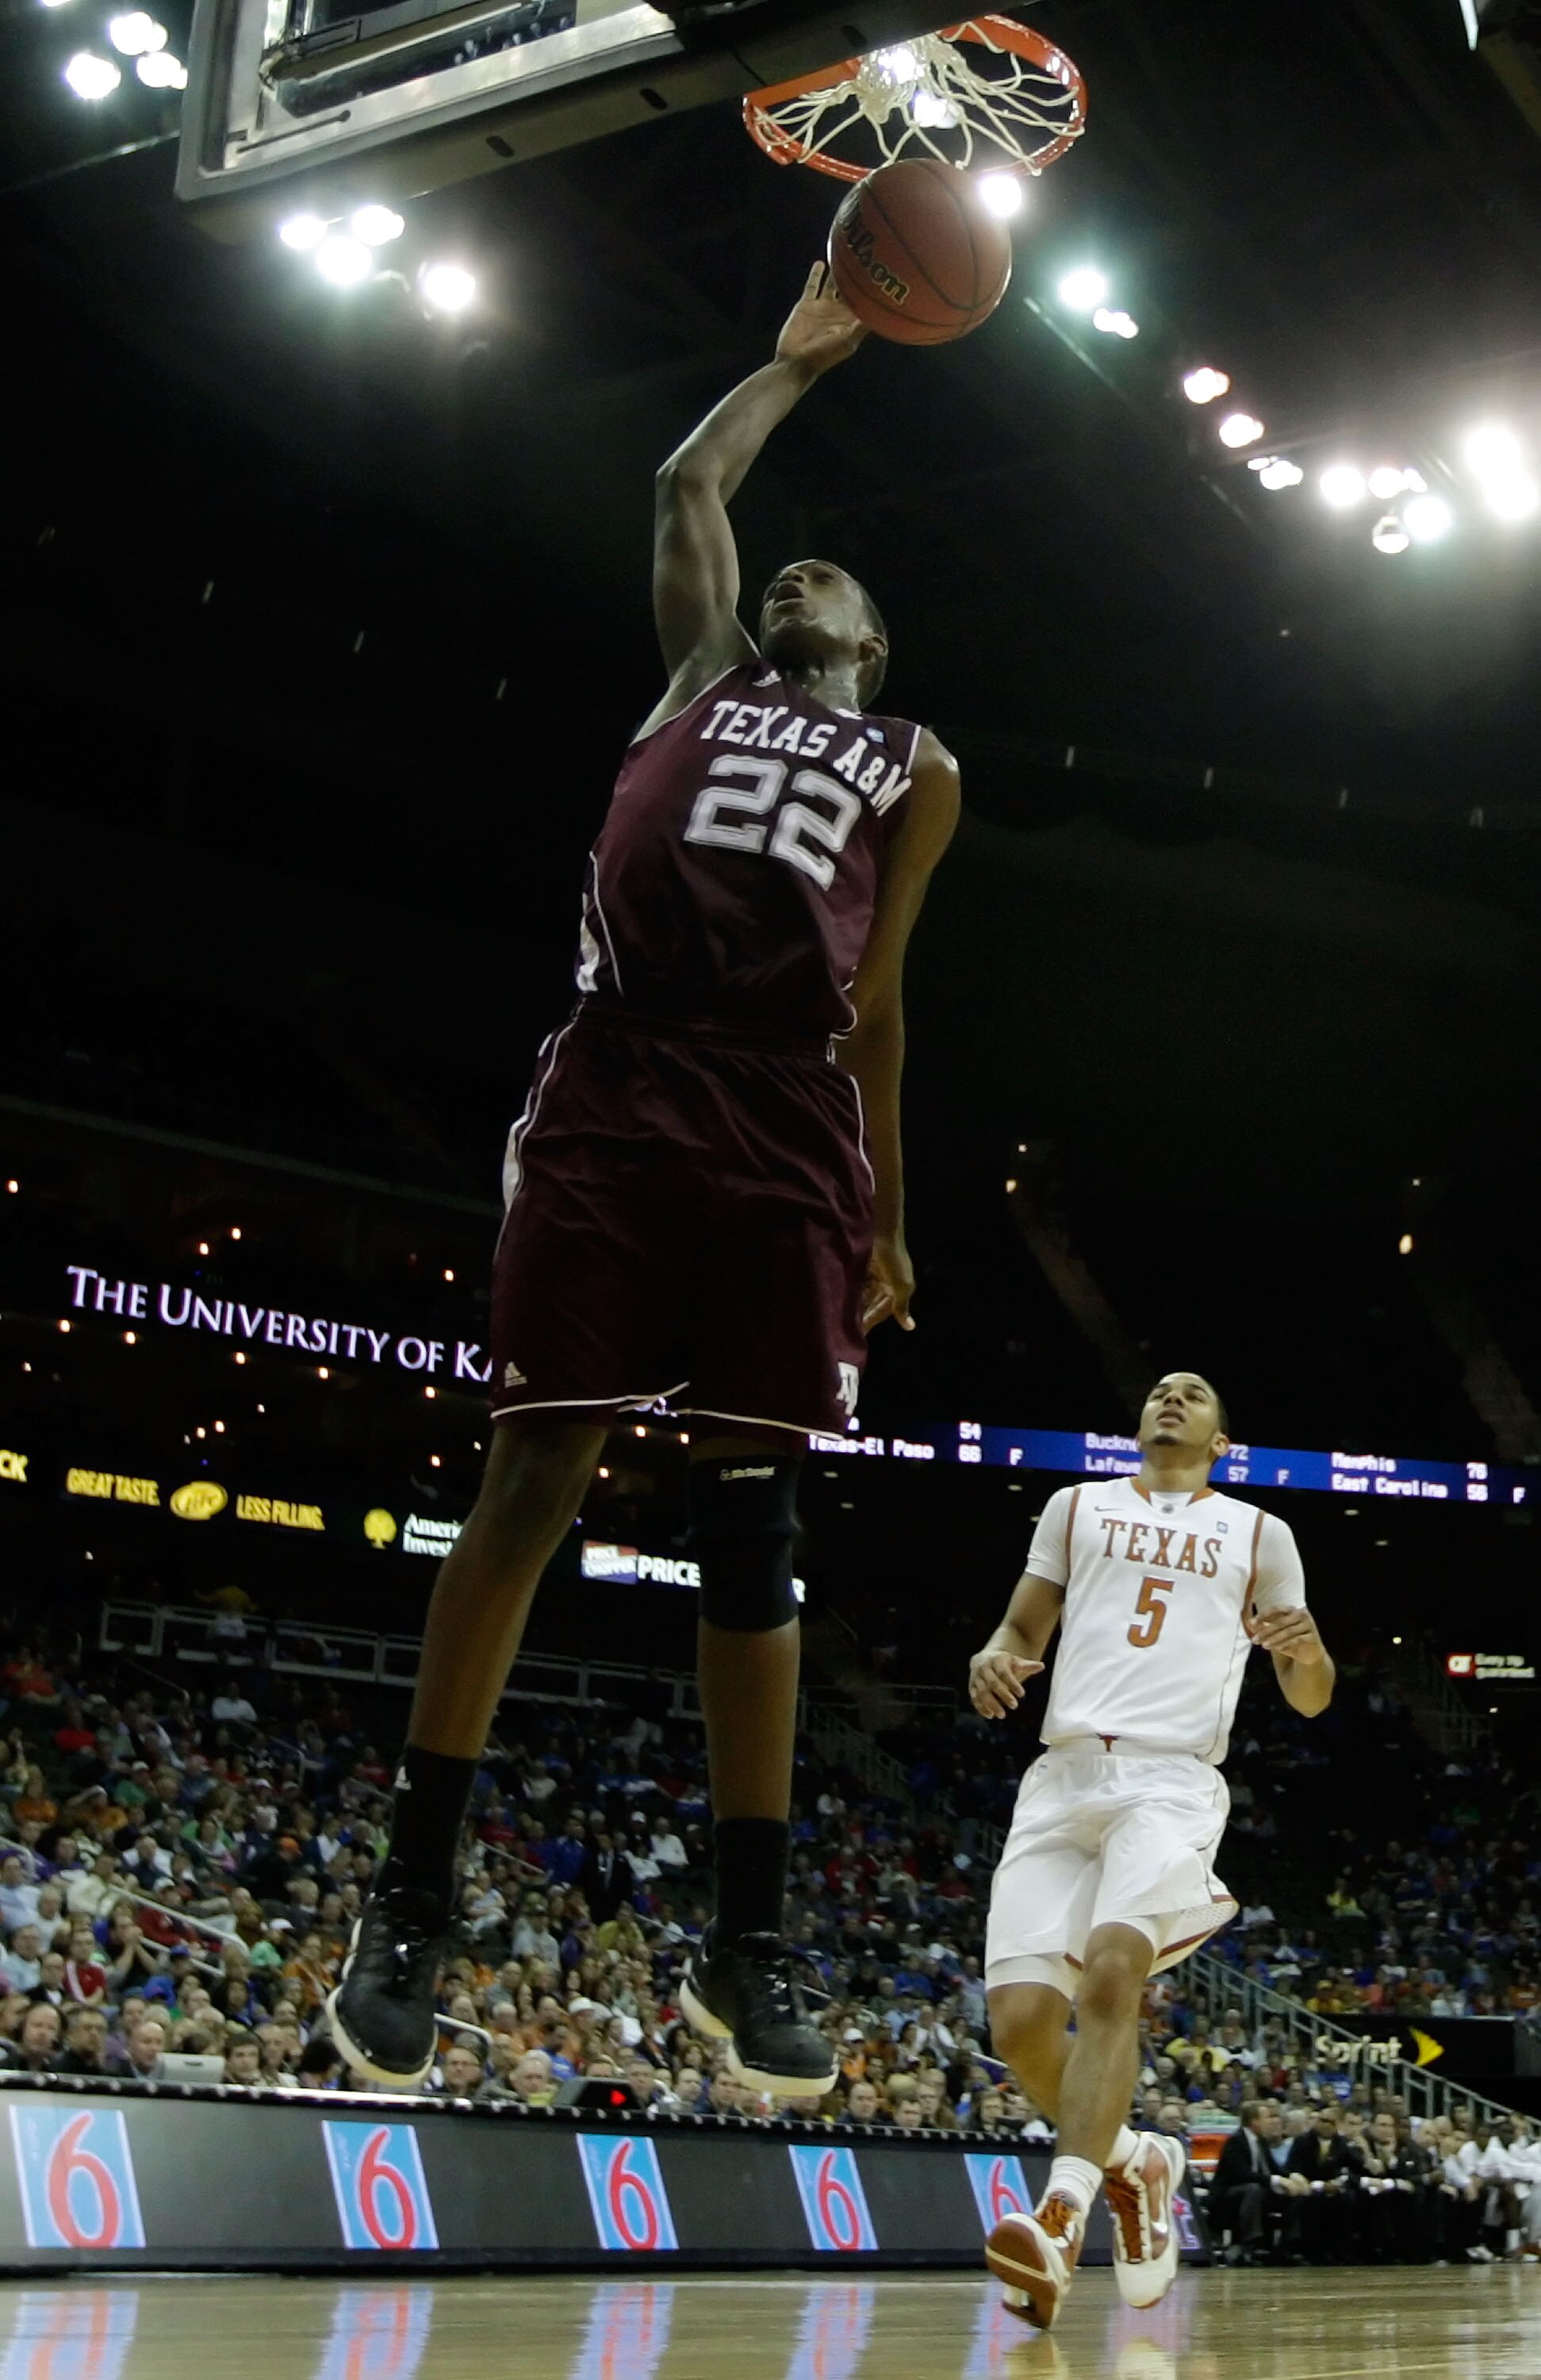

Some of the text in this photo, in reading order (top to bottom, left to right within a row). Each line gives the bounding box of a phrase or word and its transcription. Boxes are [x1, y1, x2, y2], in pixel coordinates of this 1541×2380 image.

[700, 701, 911, 817] TEXAS A&M
[683, 754, 861, 892] 22
[66, 1265, 148, 1319] THE
[159, 1283, 390, 1363] UNIVERSITY
[397, 1336, 445, 1373] OF
[892, 1439, 934, 1459] Paso
[1008, 1448, 1023, 1465] F
[1229, 1444, 1249, 1461] 72
[1229, 1465, 1290, 1485] 57 F
[1331, 1452, 1396, 1472] Memphis
[67, 1468, 114, 1499] GREAT
[1331, 1473, 1369, 1492] East
[1374, 1476, 1448, 1499] Carolina
[1512, 1487, 1526, 1503] F
[236, 1494, 271, 1522] LESS
[638, 1554, 701, 1587] PRICE
[1099, 1518, 1222, 1578] TEXAS
[1127, 1576, 1175, 1648] 5
[1315, 2035, 1402, 2063] Sprint
[45, 2109, 122, 2248] 6
[354, 2125, 419, 2248] 6
[605, 2136, 661, 2250] 6
[816, 2150, 861, 2250] 6
